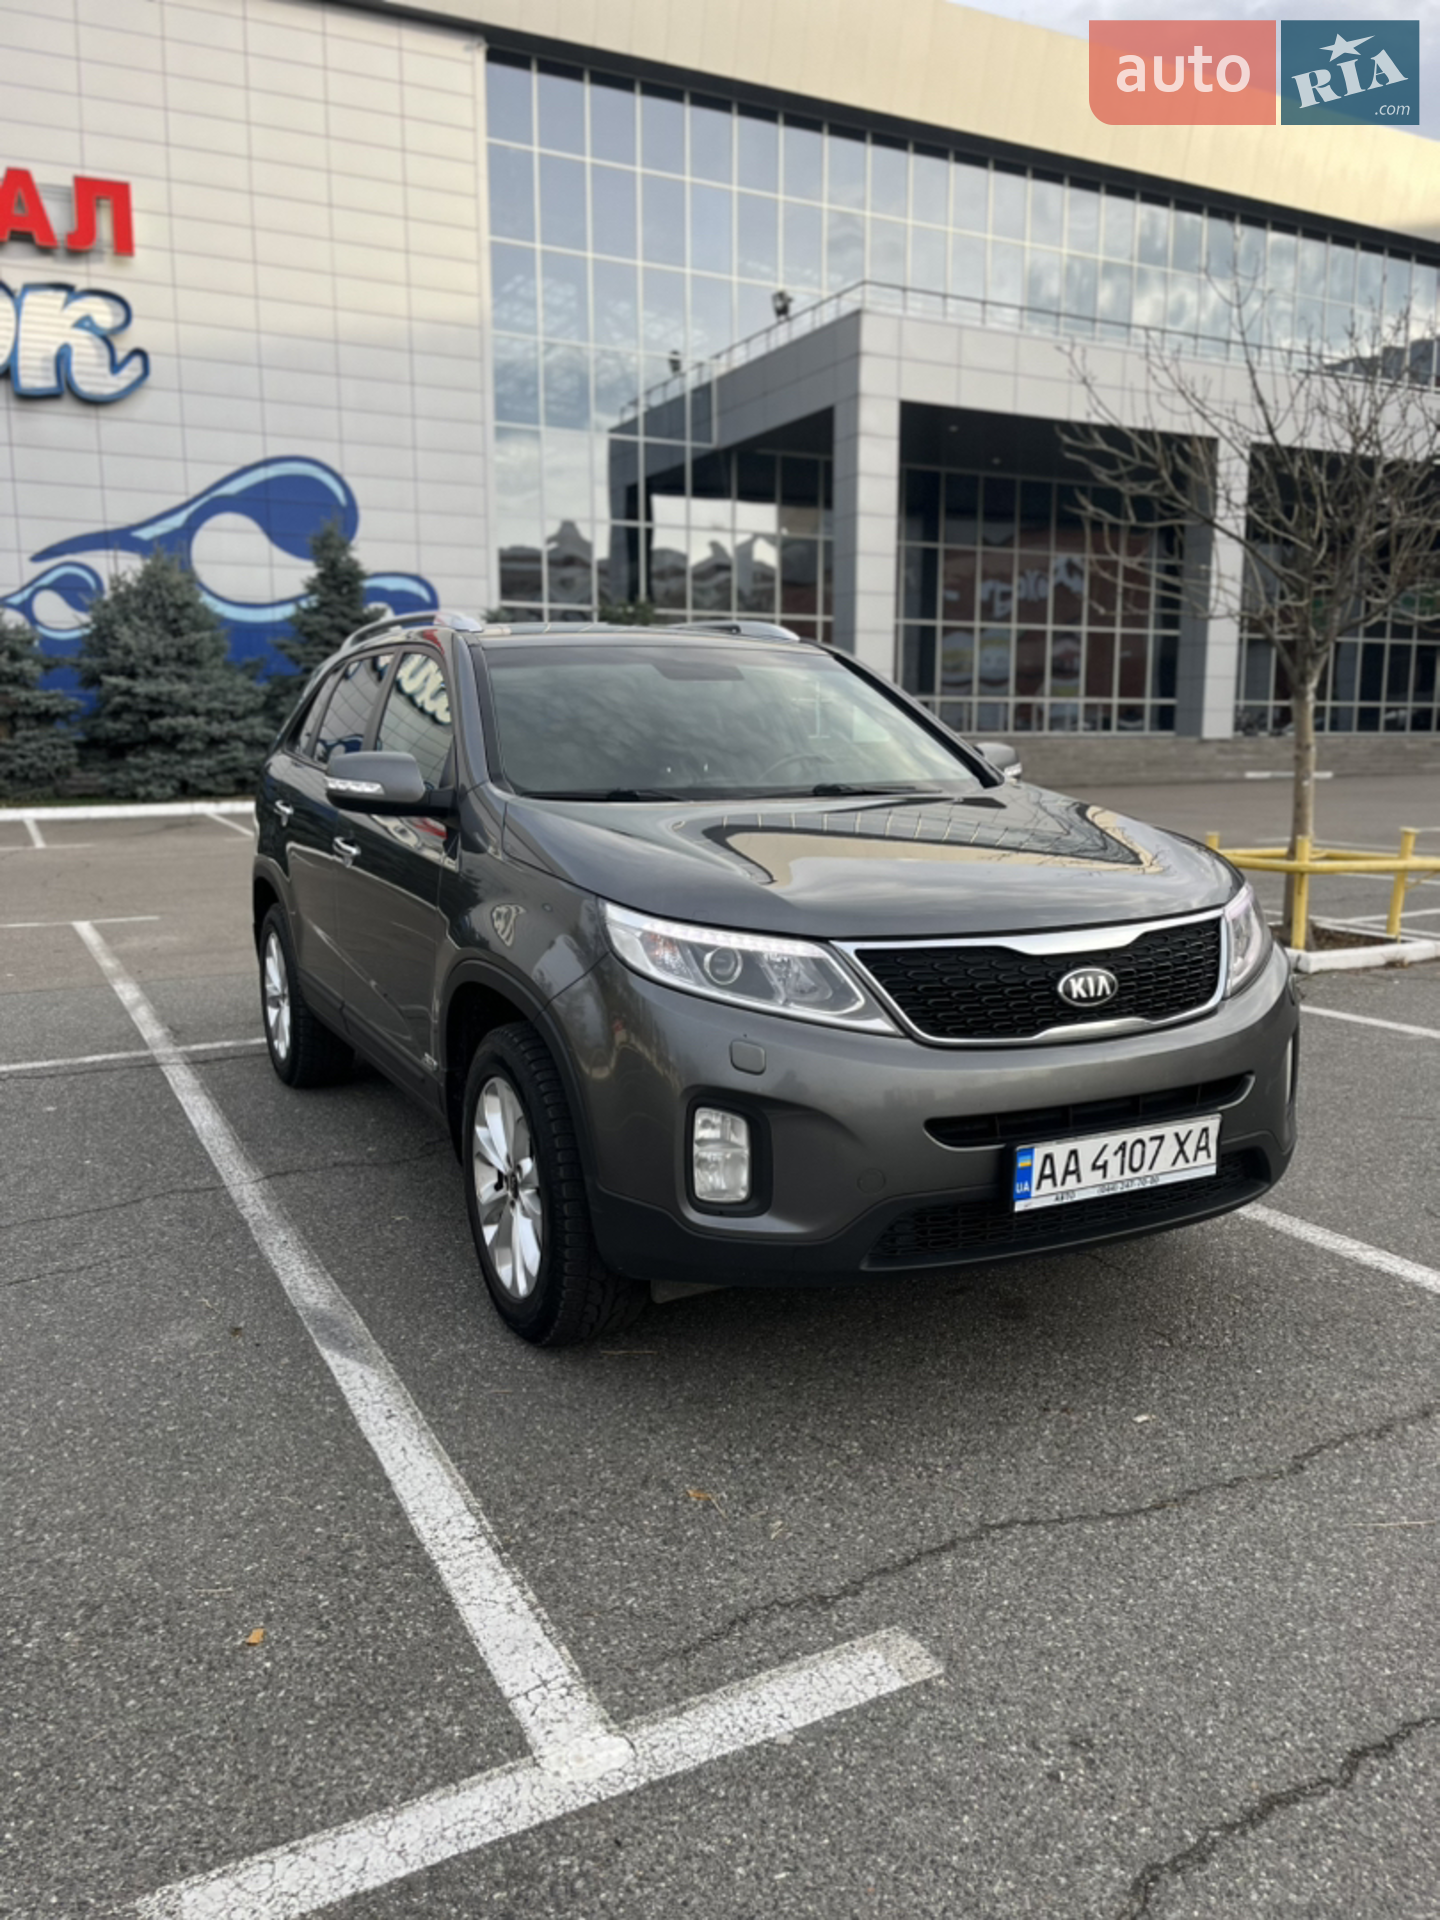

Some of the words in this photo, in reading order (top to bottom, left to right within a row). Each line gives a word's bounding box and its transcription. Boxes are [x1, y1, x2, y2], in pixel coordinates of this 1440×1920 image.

[1069, 975, 1112, 1000] KIA
[1036, 1149, 1082, 1190] AA
[1091, 1135, 1165, 1179] 4107
[1171, 1126, 1212, 1168] XA
[1015, 1180, 1031, 1195] UA
